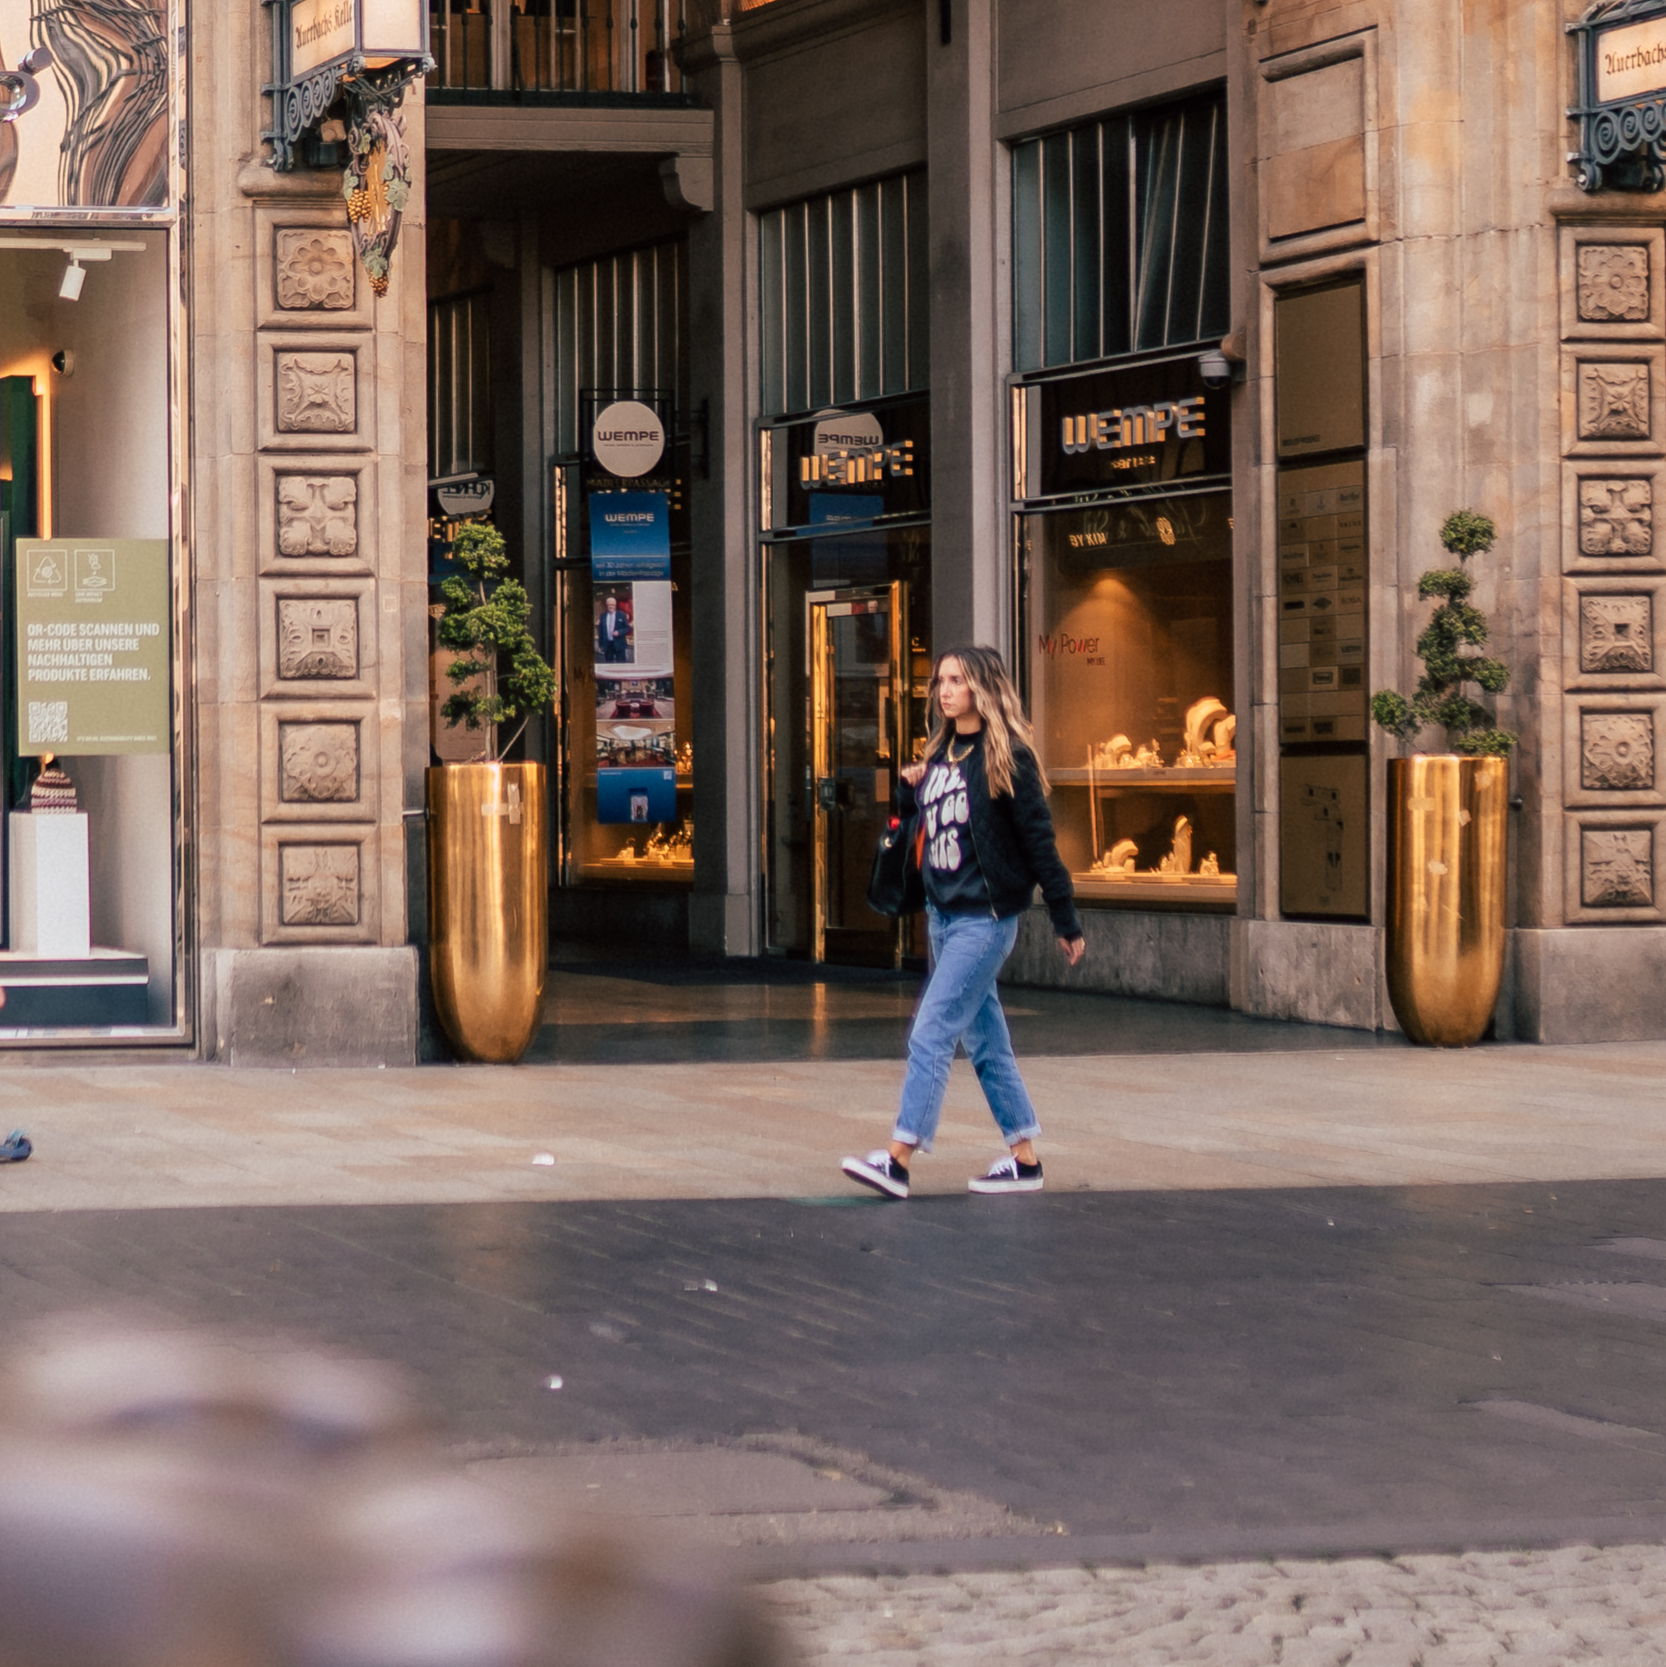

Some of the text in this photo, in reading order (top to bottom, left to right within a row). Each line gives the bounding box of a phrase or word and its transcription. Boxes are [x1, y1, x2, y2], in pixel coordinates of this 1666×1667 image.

[1062, 396, 1206, 455] WEMPE
[597, 431, 660, 441] WEMPE
[604, 513, 655, 522] WEMPE
[27, 623, 160, 636] QR-CODE SCANNEN UND
[27, 638, 61, 651] MEHR
[94, 638, 140, 651] UNSERE
[1038, 633, 1100, 660] My Power
[27, 653, 113, 667] NACHHALTIGEN
[27, 668, 152, 682] PRODUKTE ERFAHREN.
